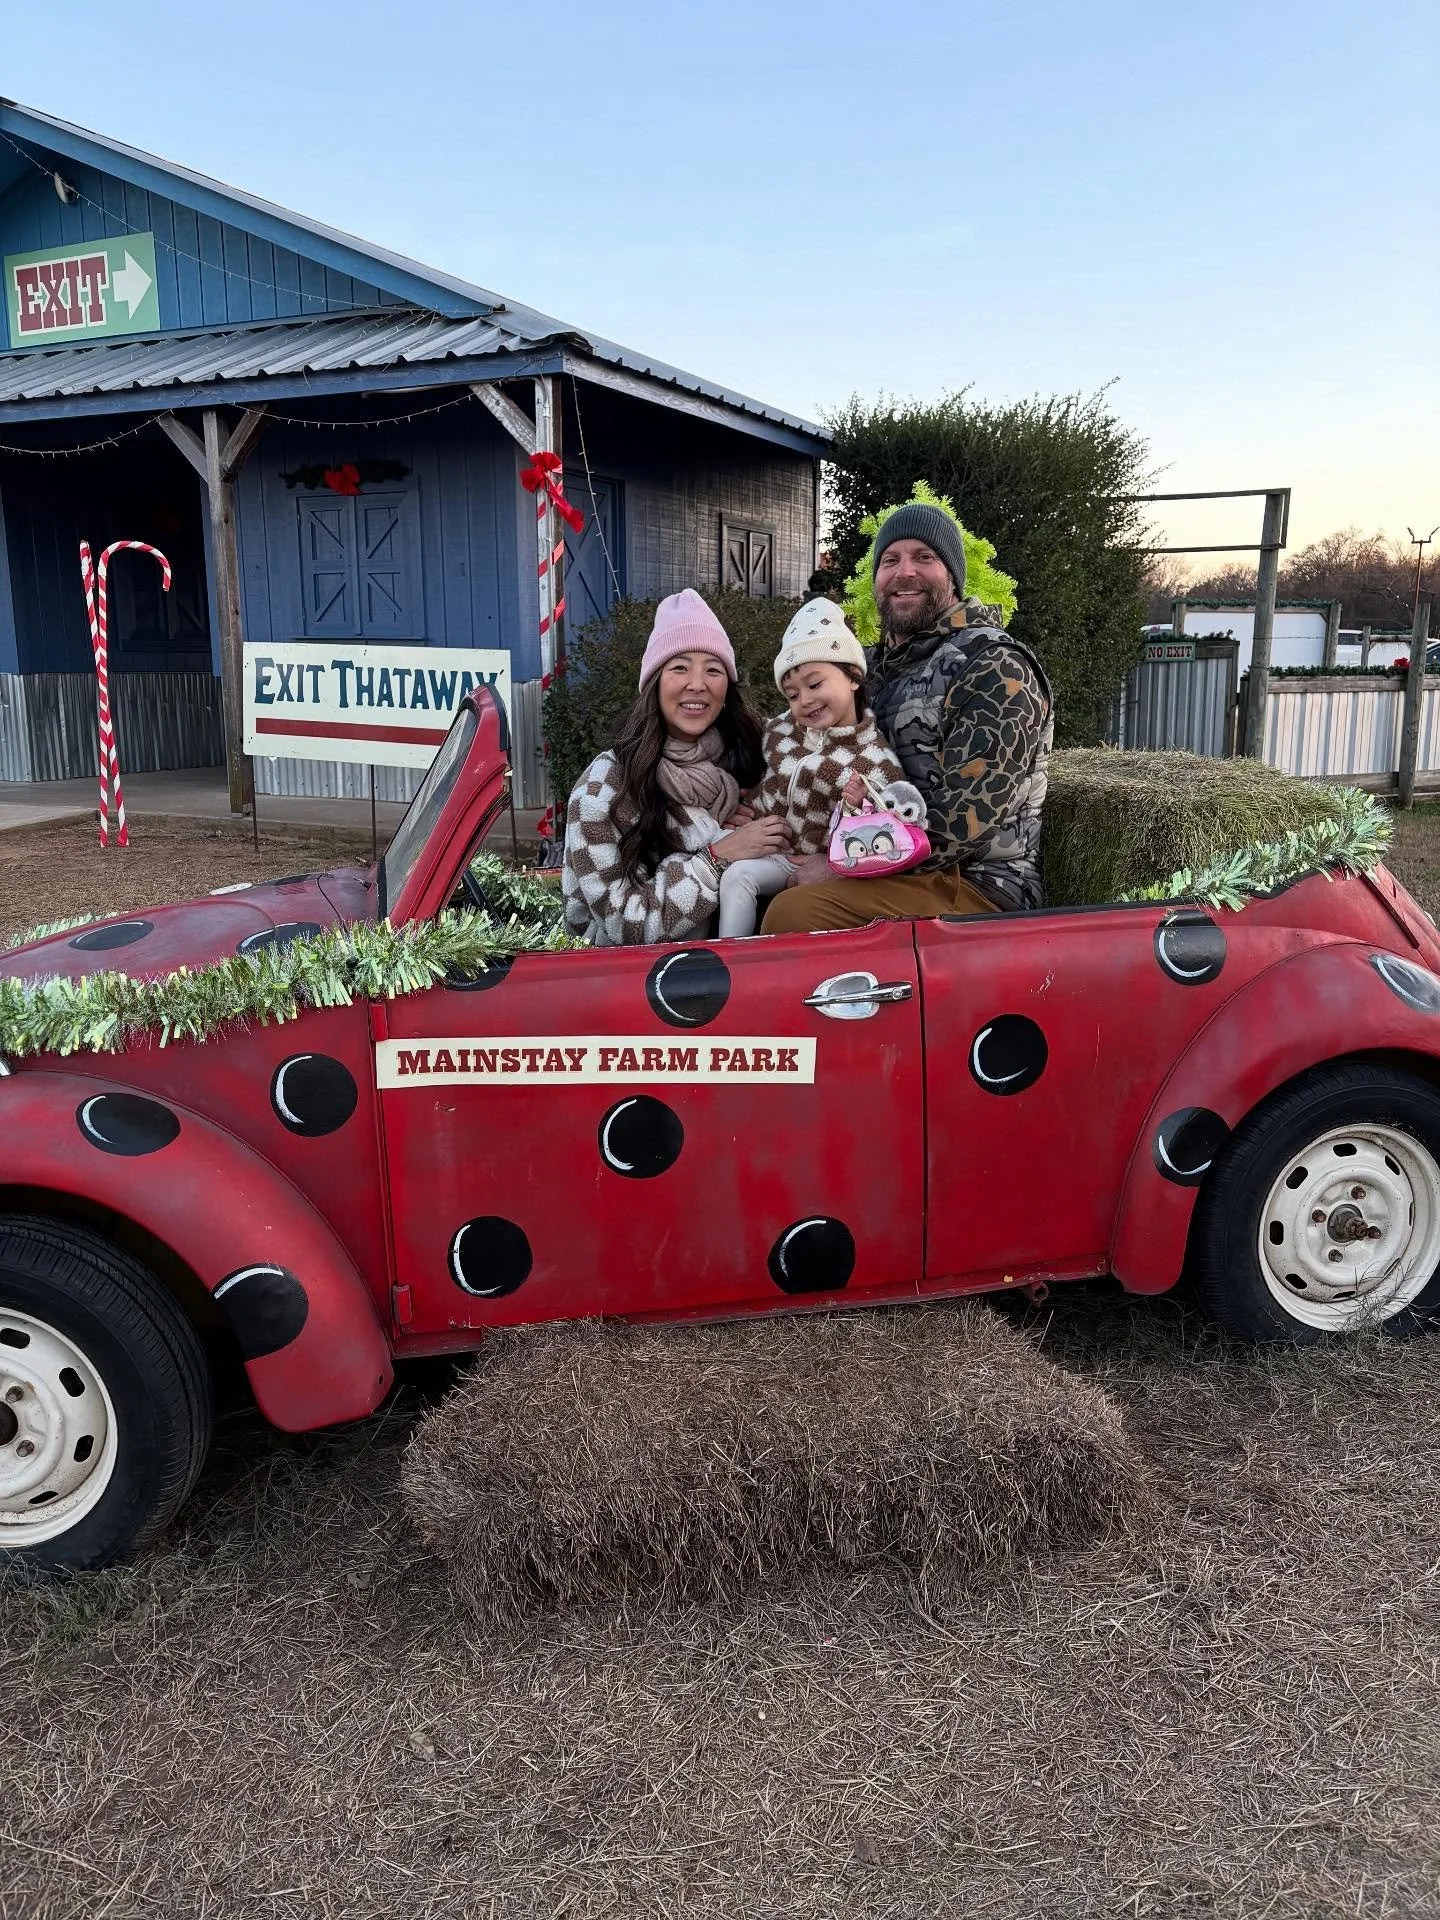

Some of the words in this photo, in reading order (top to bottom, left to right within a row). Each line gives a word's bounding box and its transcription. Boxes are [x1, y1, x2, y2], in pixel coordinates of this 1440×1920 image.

[15, 254, 108, 334] EXIT
[1147, 646, 1163, 658] NO
[1166, 646, 1193, 658] EXIT
[254, 657, 325, 705] EXIT
[397, 1048, 588, 1075] MAINSTAY
[598, 1047, 699, 1073] FARM
[709, 1047, 800, 1073] PARK
